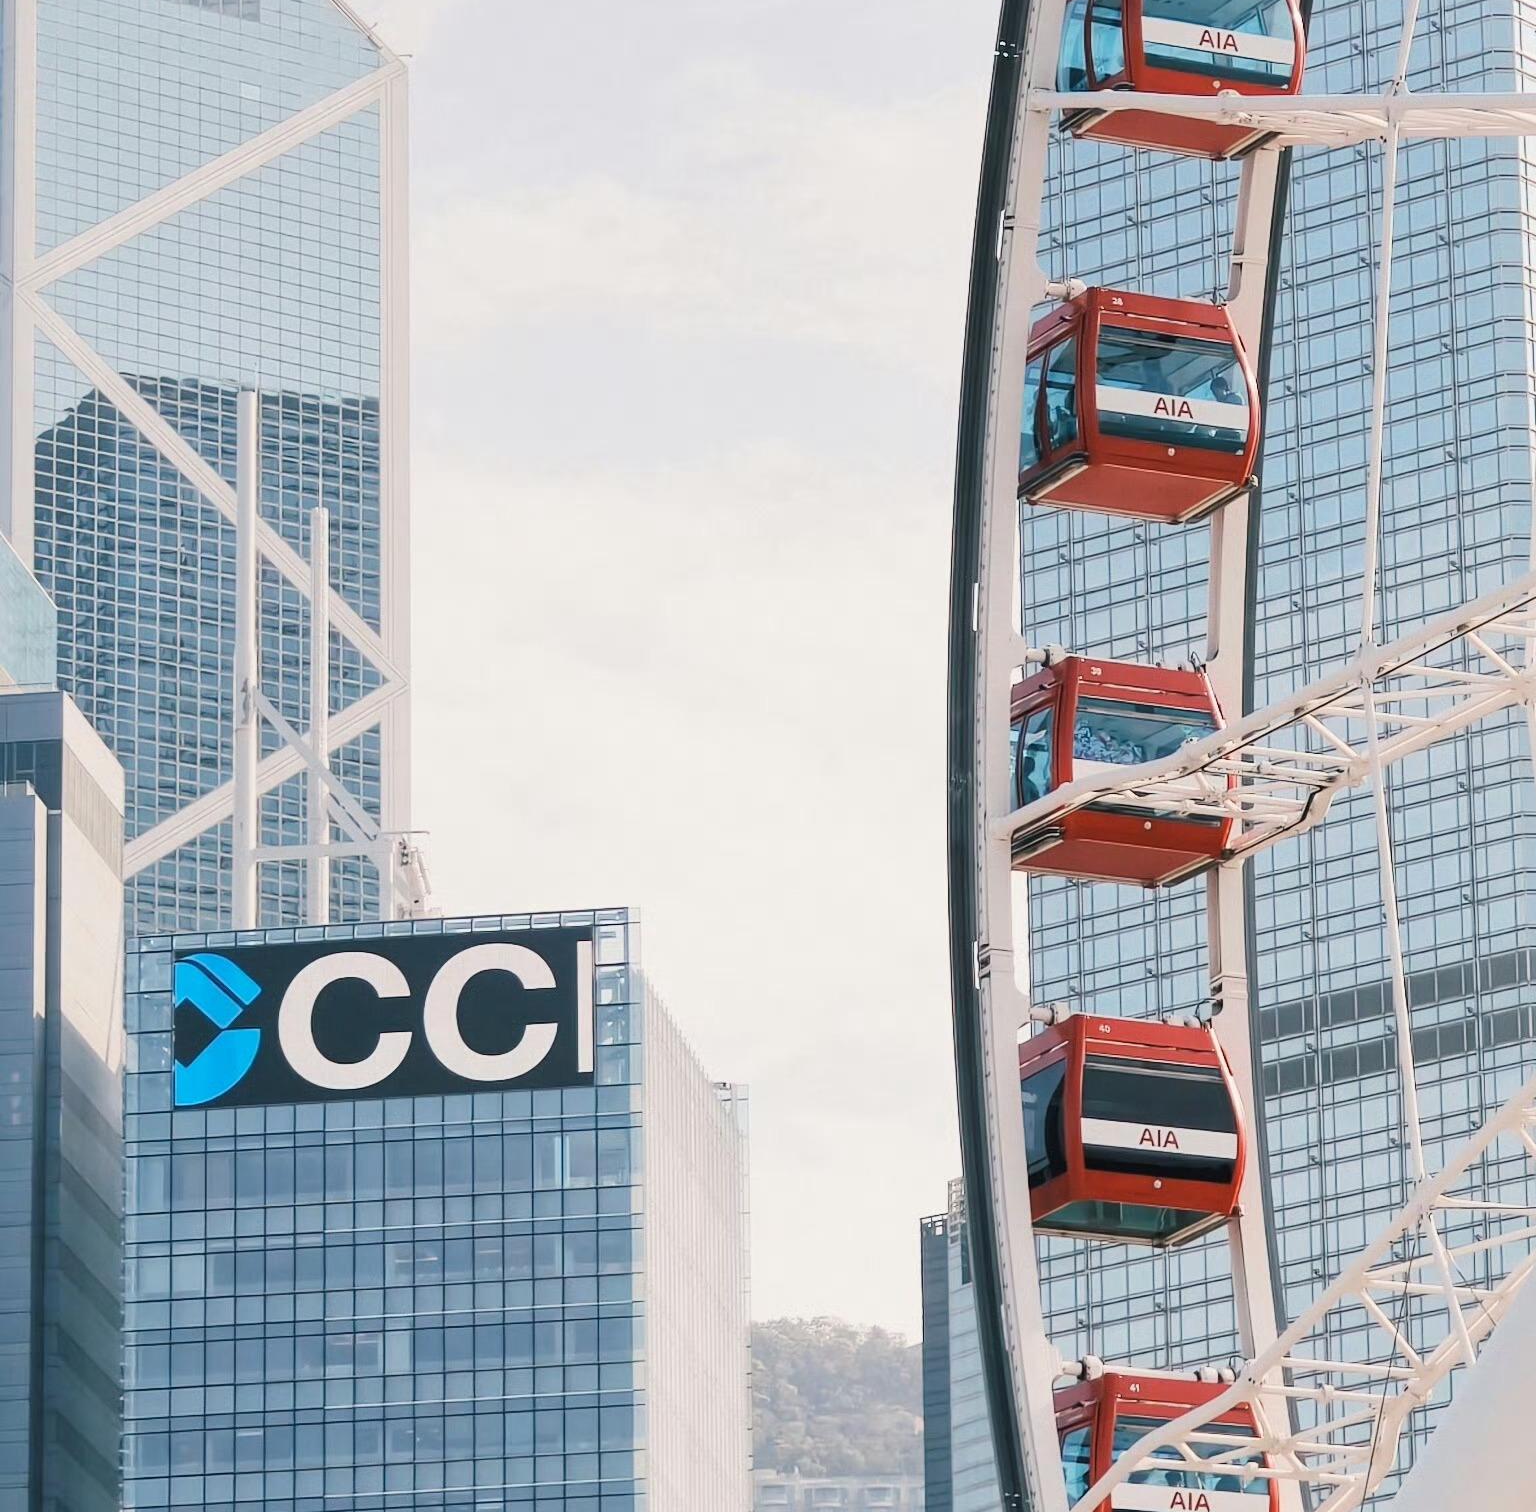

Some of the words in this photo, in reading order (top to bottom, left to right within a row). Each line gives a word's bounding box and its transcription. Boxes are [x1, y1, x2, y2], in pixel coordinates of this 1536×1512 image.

[1198, 29, 1239, 52] AIA
[1153, 397, 1194, 419] AIA
[1138, 1128, 1180, 1149] AIA
[1169, 1491, 1211, 1512] AIA
